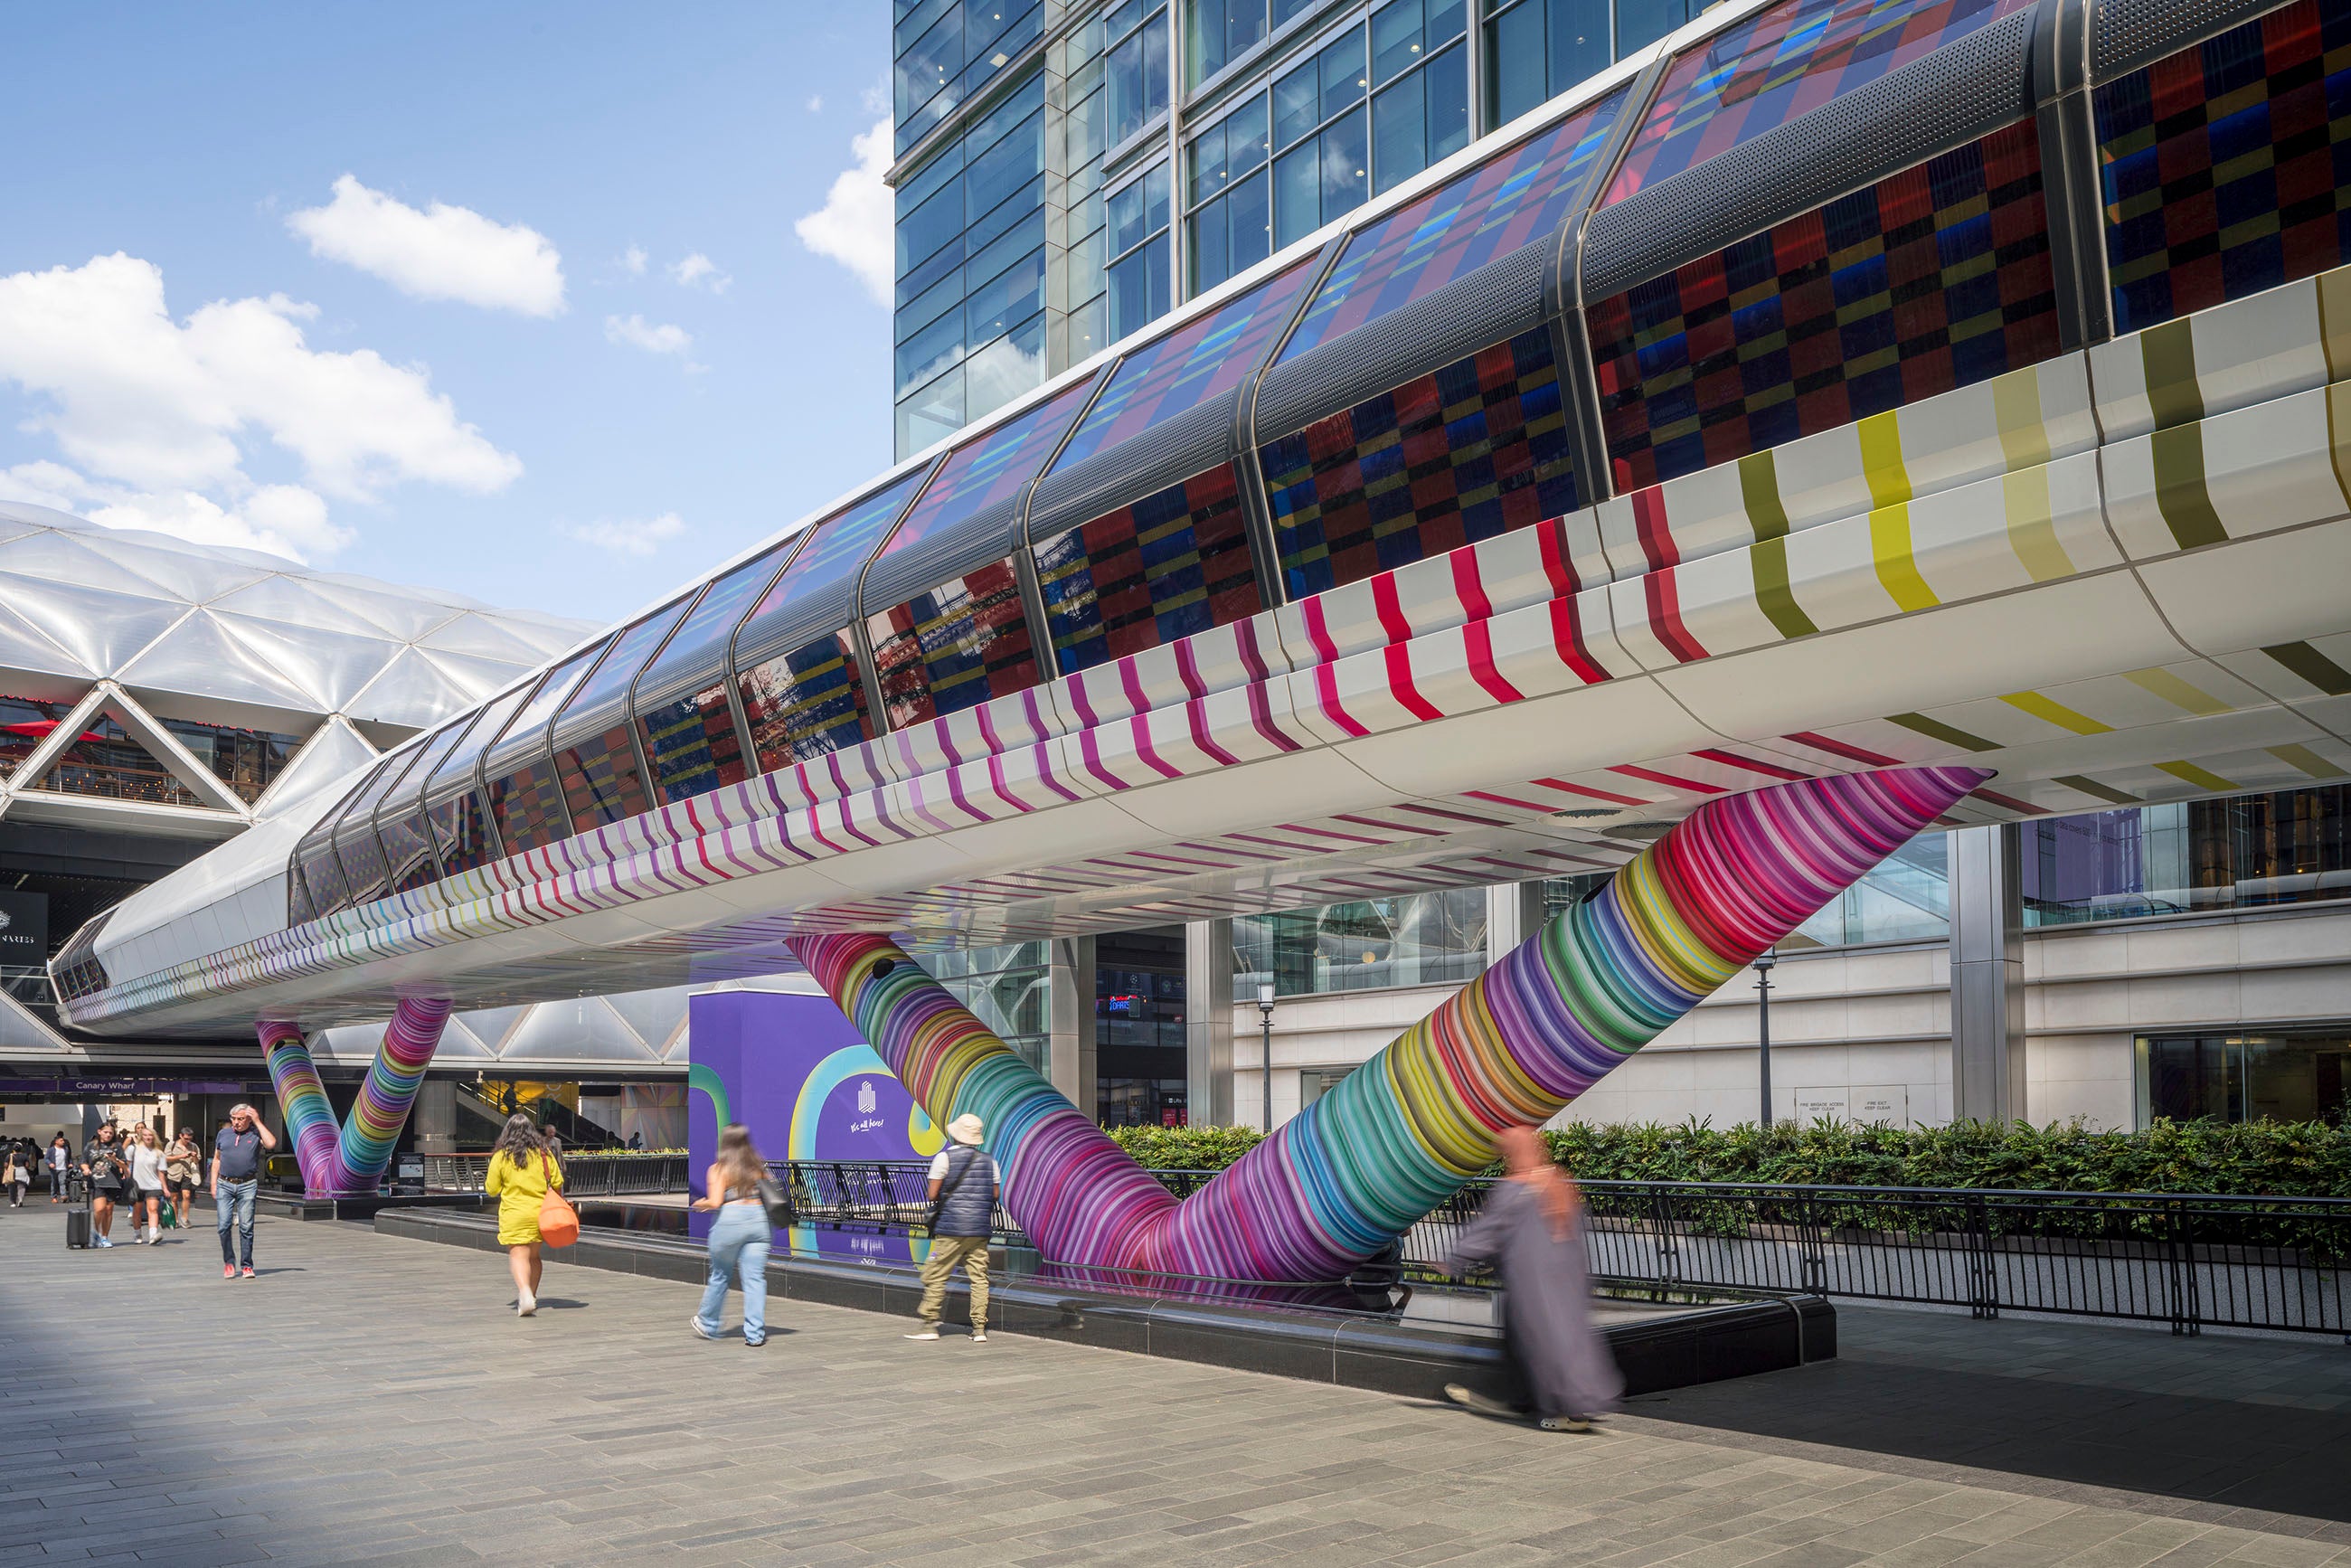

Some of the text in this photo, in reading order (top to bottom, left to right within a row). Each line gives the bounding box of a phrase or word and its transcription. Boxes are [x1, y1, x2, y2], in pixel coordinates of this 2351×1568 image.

[76, 1082, 136, 1091] Canary Wharf
[860, 1119, 868, 1129] all
